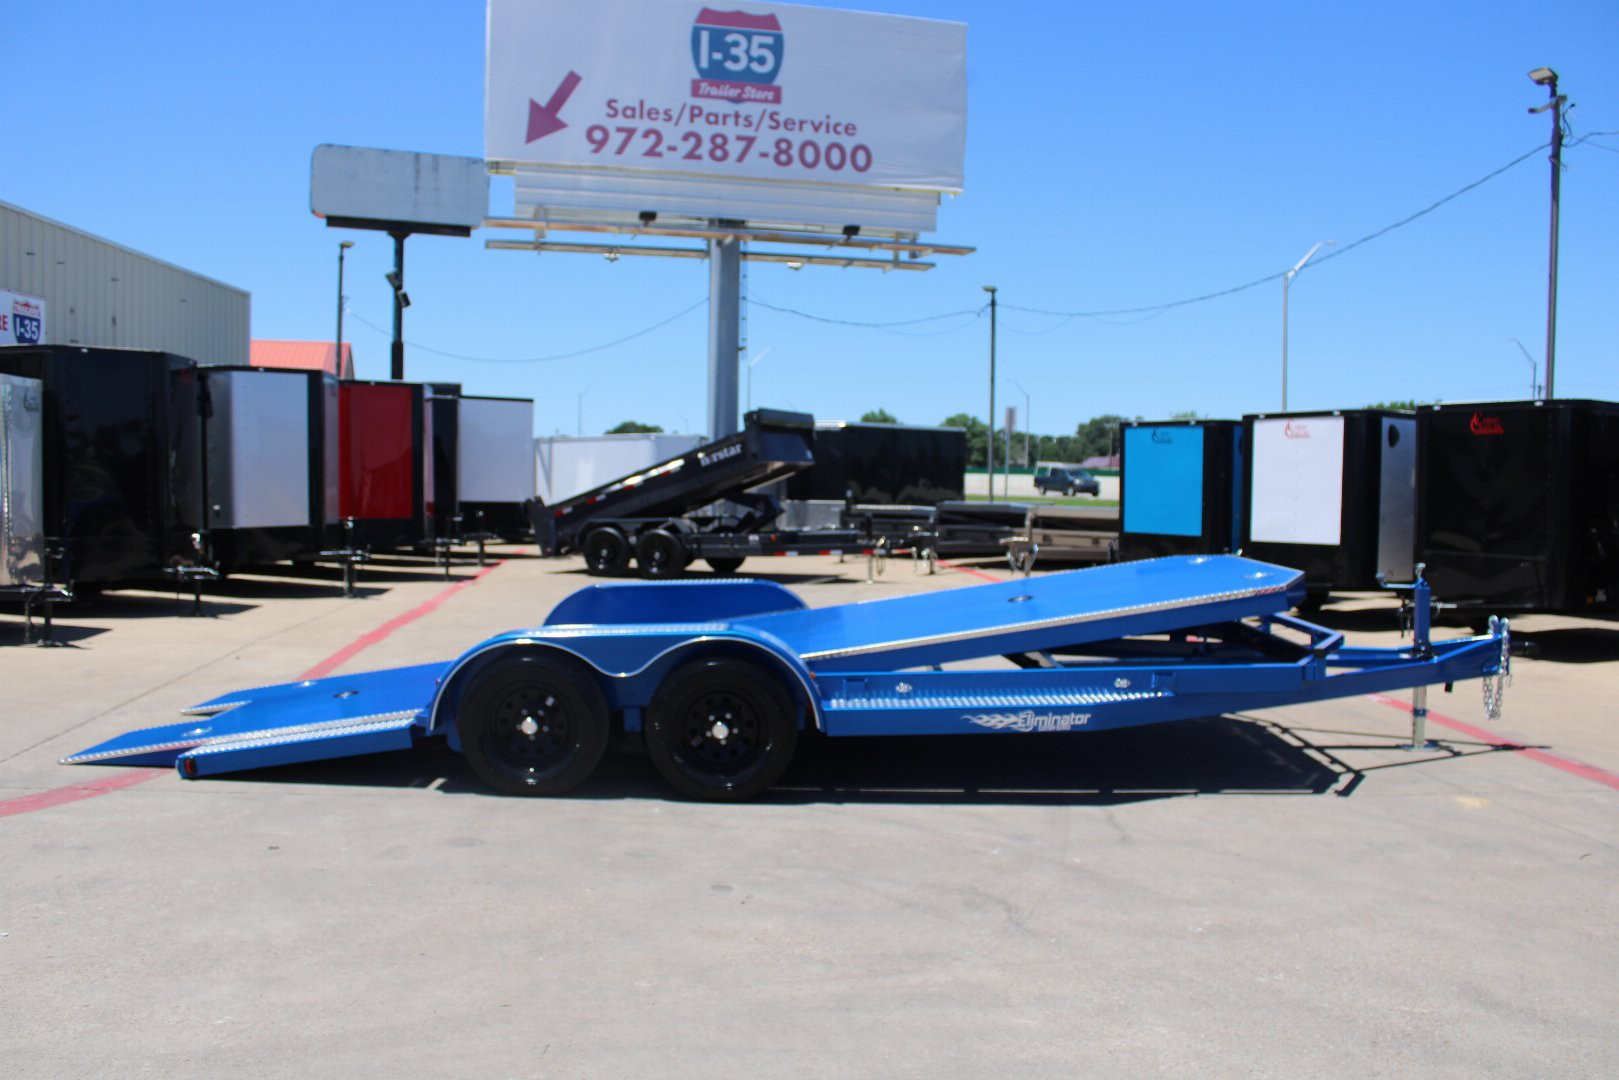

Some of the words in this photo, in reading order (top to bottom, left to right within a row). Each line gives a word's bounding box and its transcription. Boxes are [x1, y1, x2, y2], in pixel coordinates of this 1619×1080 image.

[699, 29, 776, 75] I-35
[699, 82, 741, 97] Trailer
[742, 86, 775, 101] Store
[605, 98, 858, 137] Sales/Parts/Service
[585, 124, 873, 173] 972-287-8000
[16, 318, 39, 340] I-35
